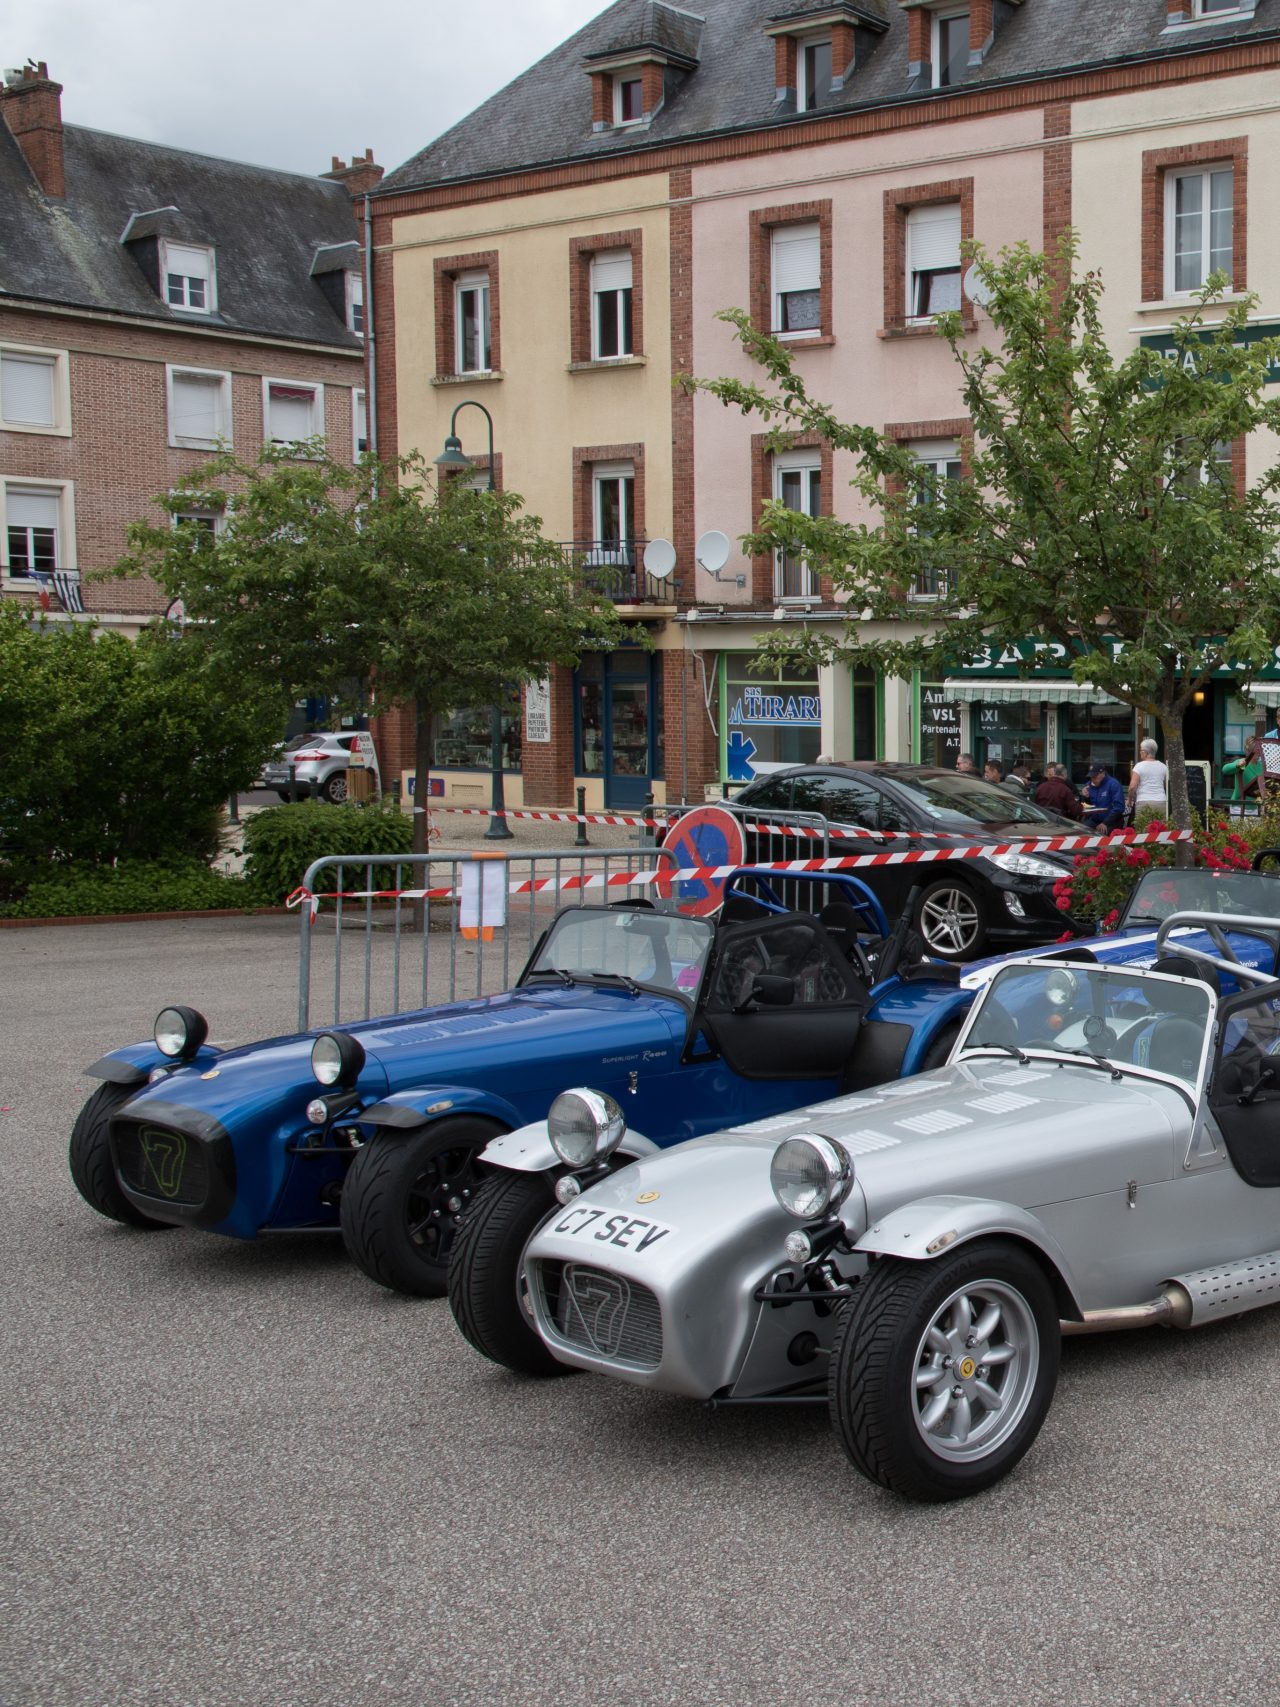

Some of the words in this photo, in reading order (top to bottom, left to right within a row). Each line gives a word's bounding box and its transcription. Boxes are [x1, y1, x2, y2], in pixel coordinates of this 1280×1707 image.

[962, 642, 1066, 669] BAR
[745, 687, 761, 697] sas
[932, 708, 956, 721] VSL
[554, 1208, 607, 1235] C7
[594, 1215, 671, 1253] SEV
